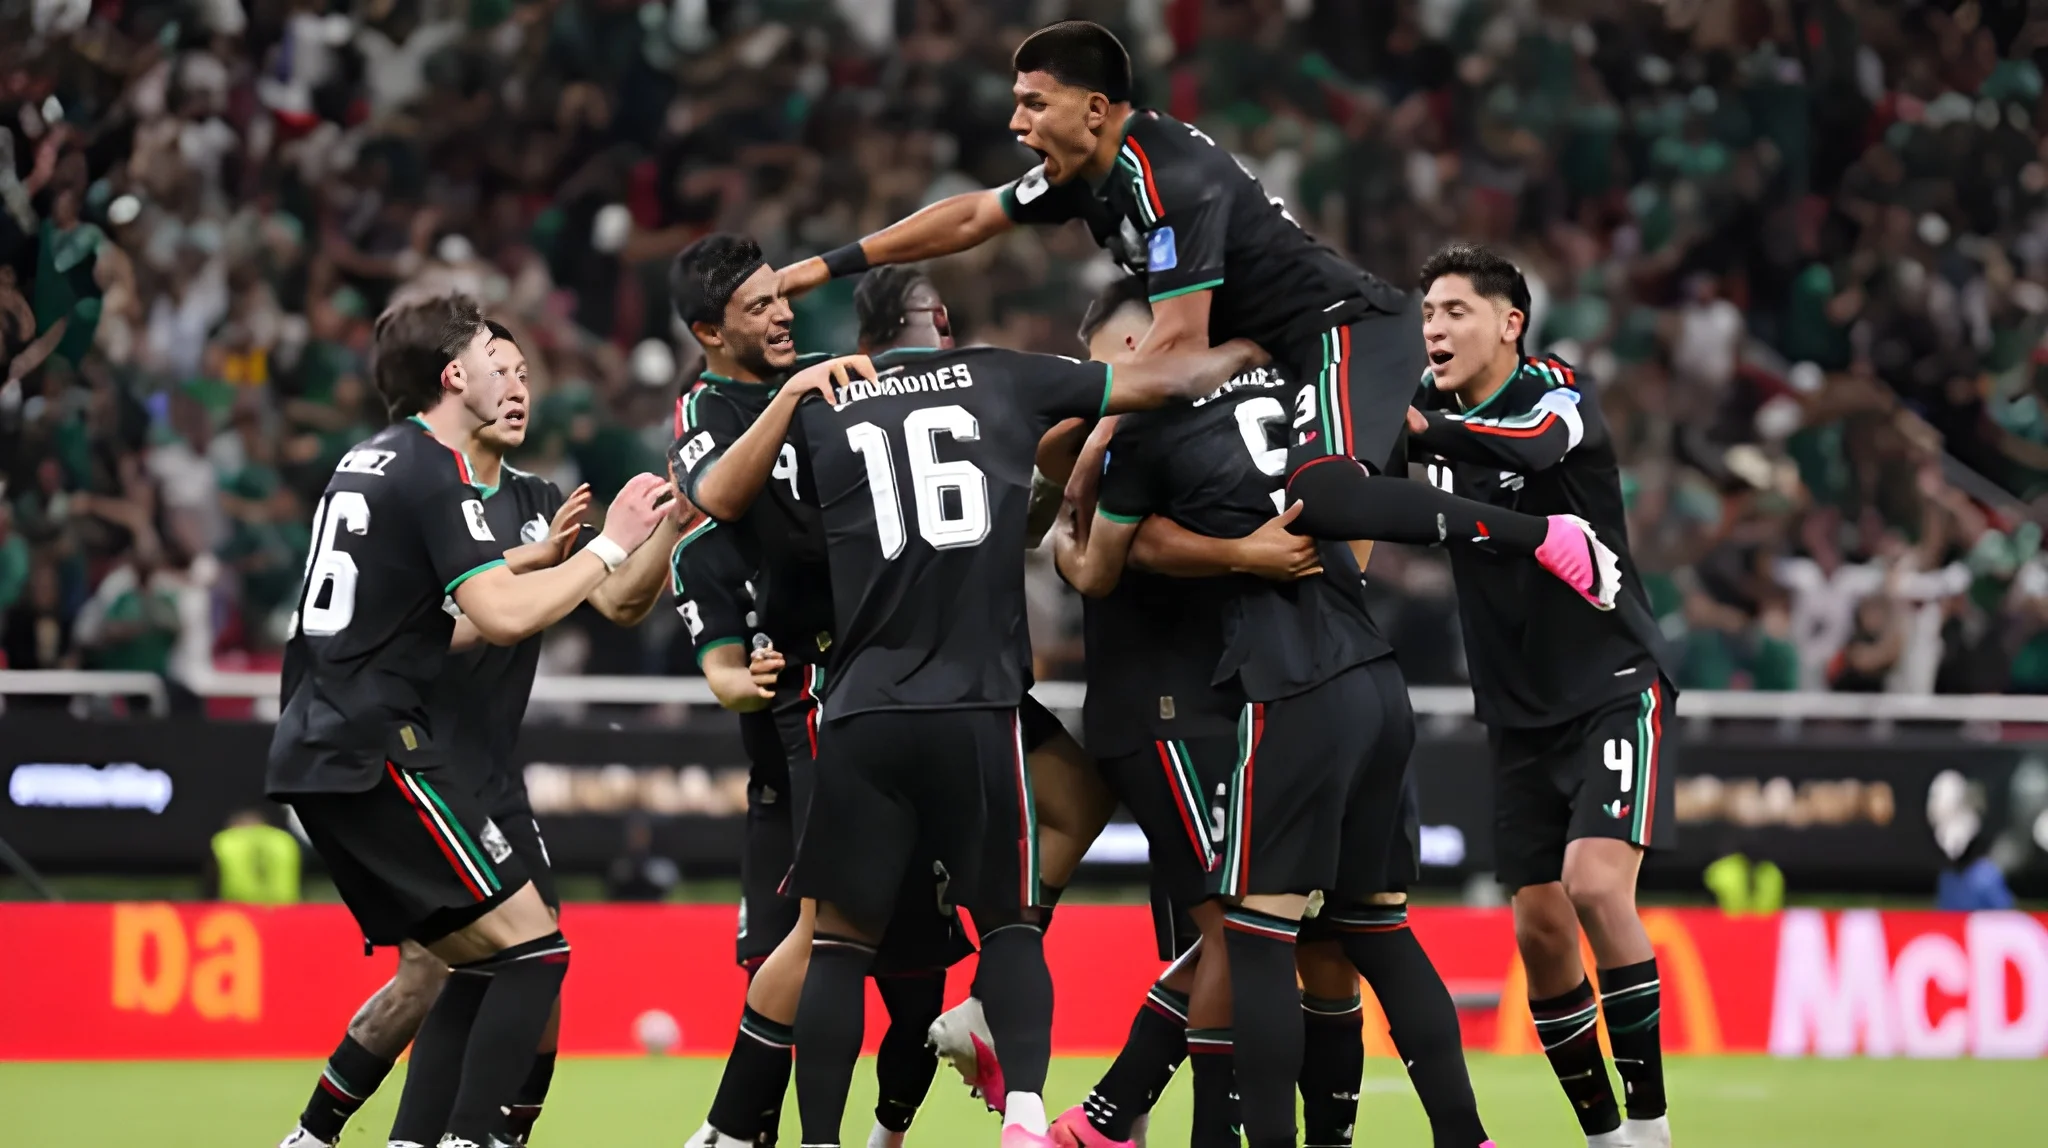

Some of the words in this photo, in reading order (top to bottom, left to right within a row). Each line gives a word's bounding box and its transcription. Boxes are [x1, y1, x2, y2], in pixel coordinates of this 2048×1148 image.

[846, 404, 991, 561] 16
[302, 490, 371, 637] 6
[1603, 738, 1633, 793] 4
[1767, 907, 2048, 1060] McD
